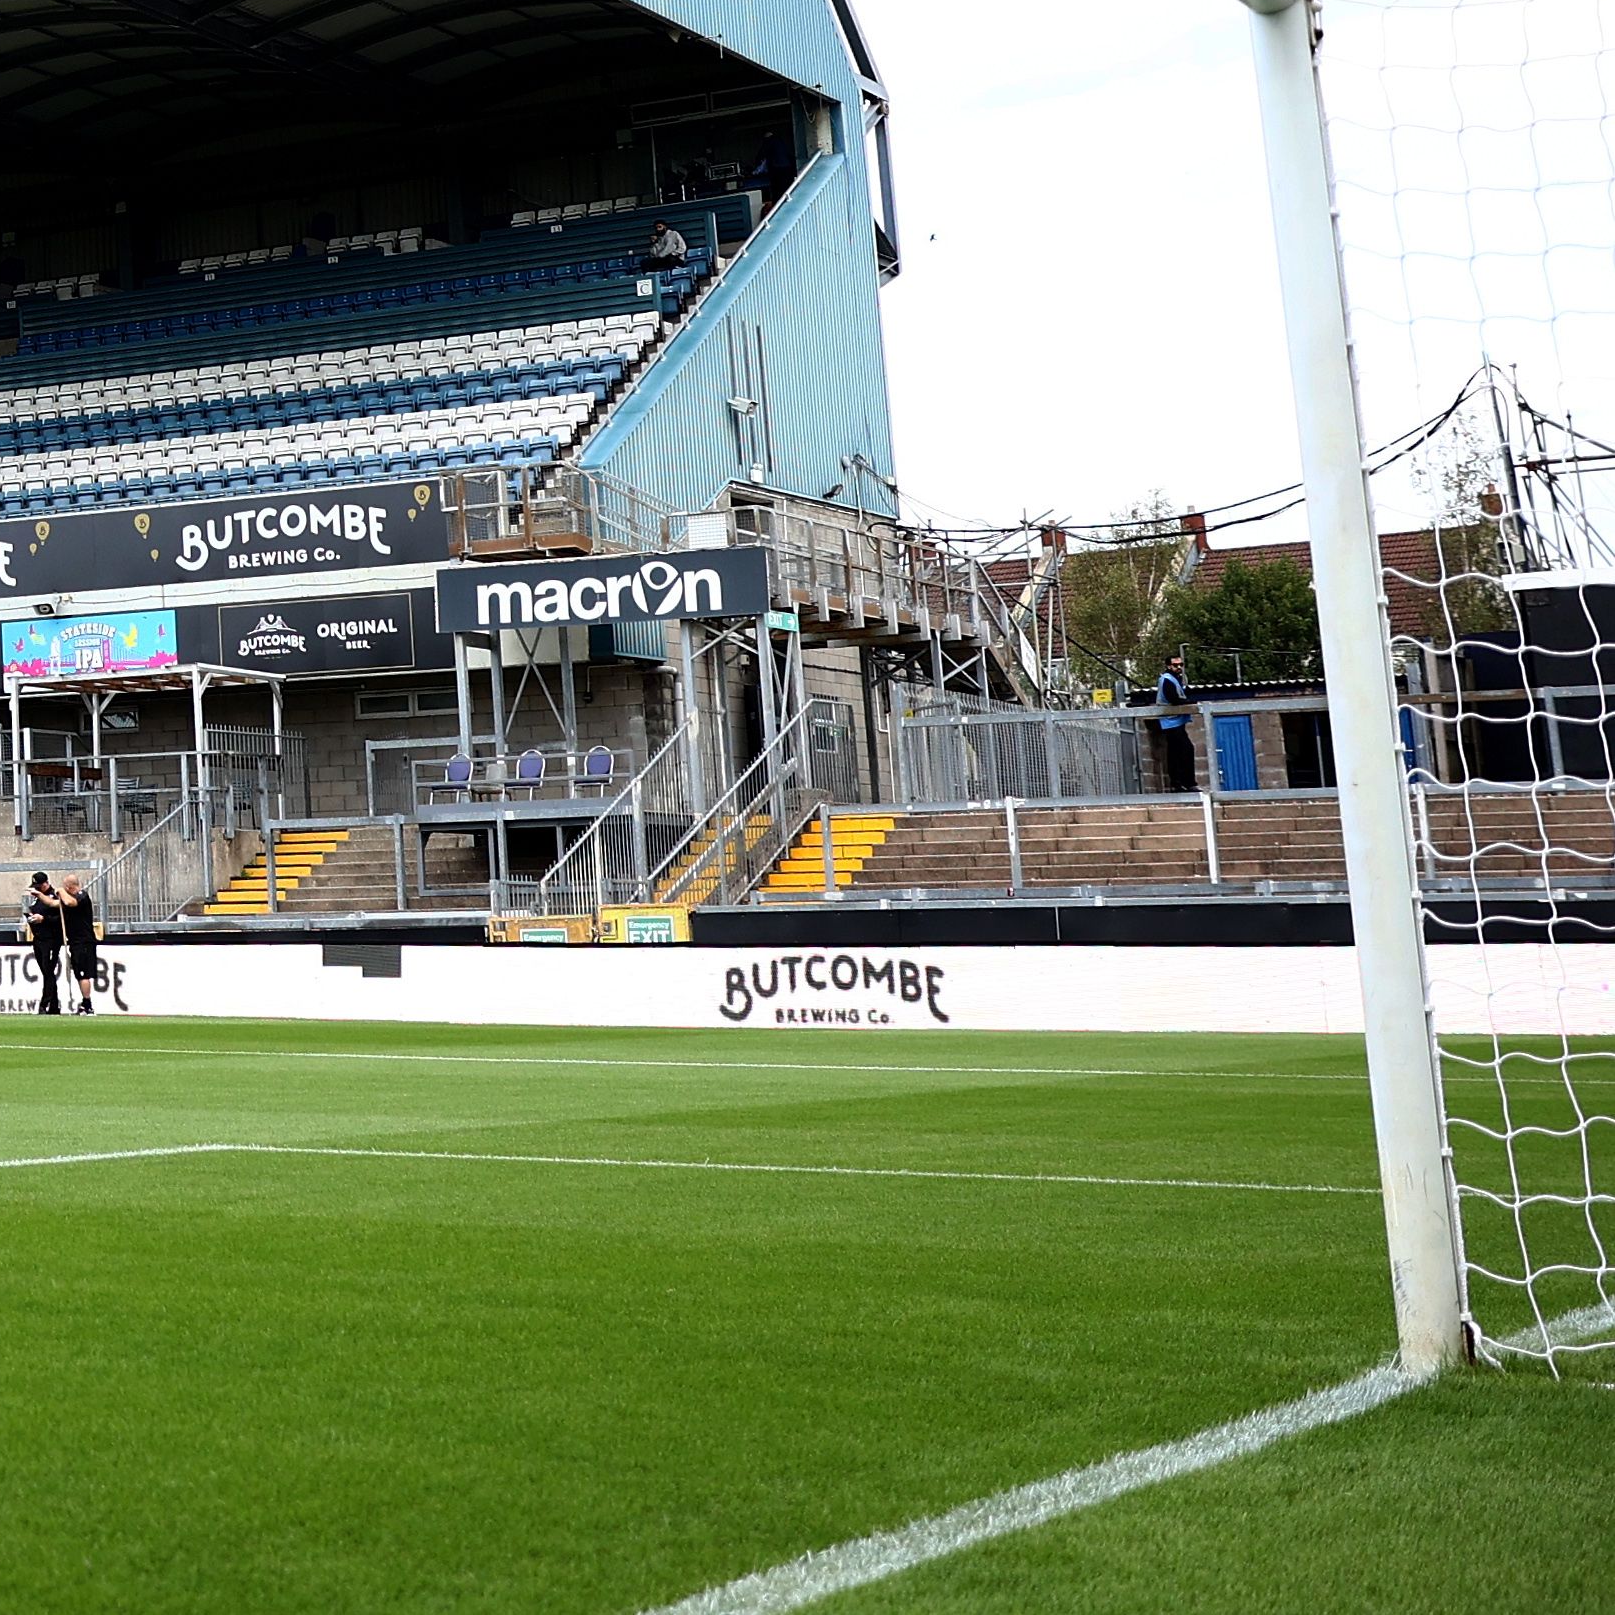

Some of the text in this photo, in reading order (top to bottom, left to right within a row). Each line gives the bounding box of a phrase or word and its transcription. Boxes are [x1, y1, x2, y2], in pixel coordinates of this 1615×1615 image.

[175, 504, 391, 571] BUTCOMBE
[228, 547, 341, 569] BREWING Co.
[476, 560, 723, 625] macron
[60, 622, 117, 642] STATESIDE
[316, 618, 398, 641] ORIGINAL
[238, 634, 307, 657] BUTCOMBE
[345, 640, 371, 650] BEER
[74, 648, 104, 670] IPA
[629, 921, 670, 930] Emergency
[629, 930, 670, 943] EXIT
[522, 933, 564, 943] Emergency
[719, 954, 950, 1024] BUTCOMBE
[775, 1008, 861, 1024] BREWING
